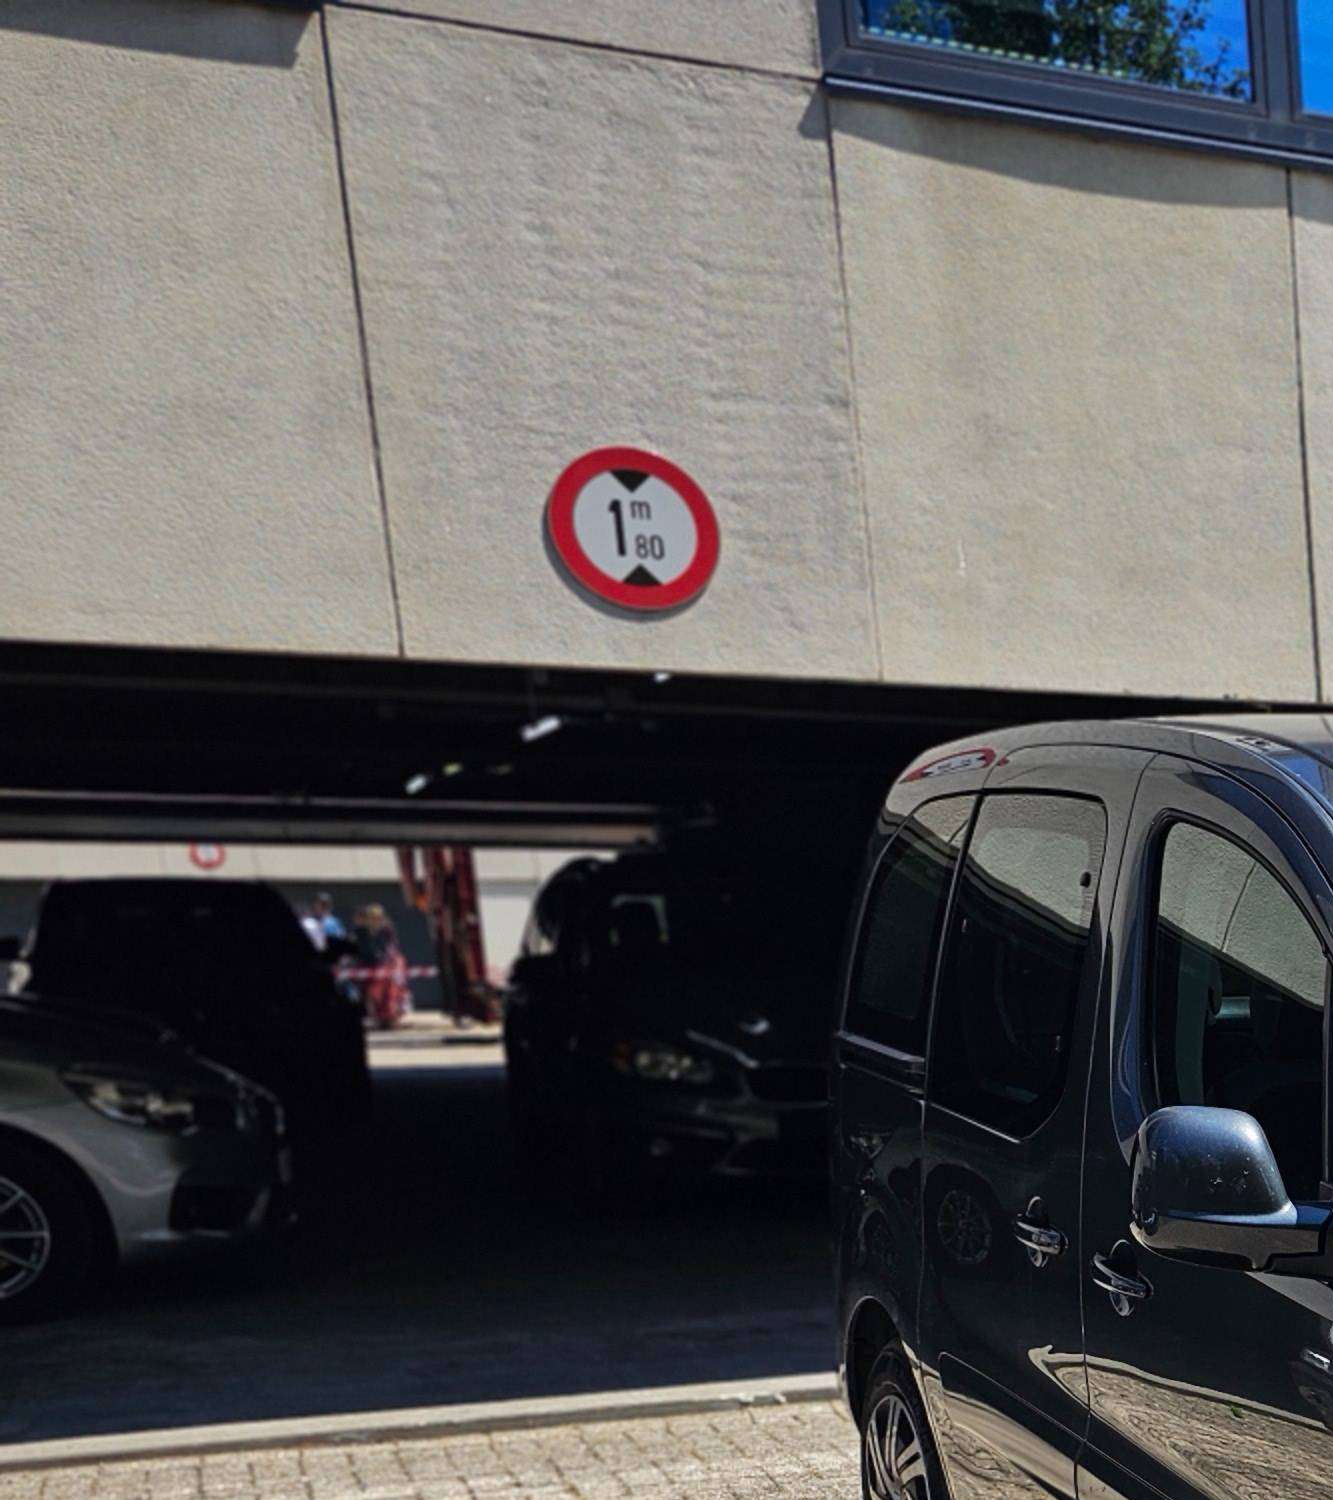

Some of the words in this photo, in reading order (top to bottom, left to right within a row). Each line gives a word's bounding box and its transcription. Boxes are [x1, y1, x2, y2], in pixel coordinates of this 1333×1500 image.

[608, 499, 626, 556] 1
[630, 500, 651, 519] m
[635, 534, 664, 560] 80
